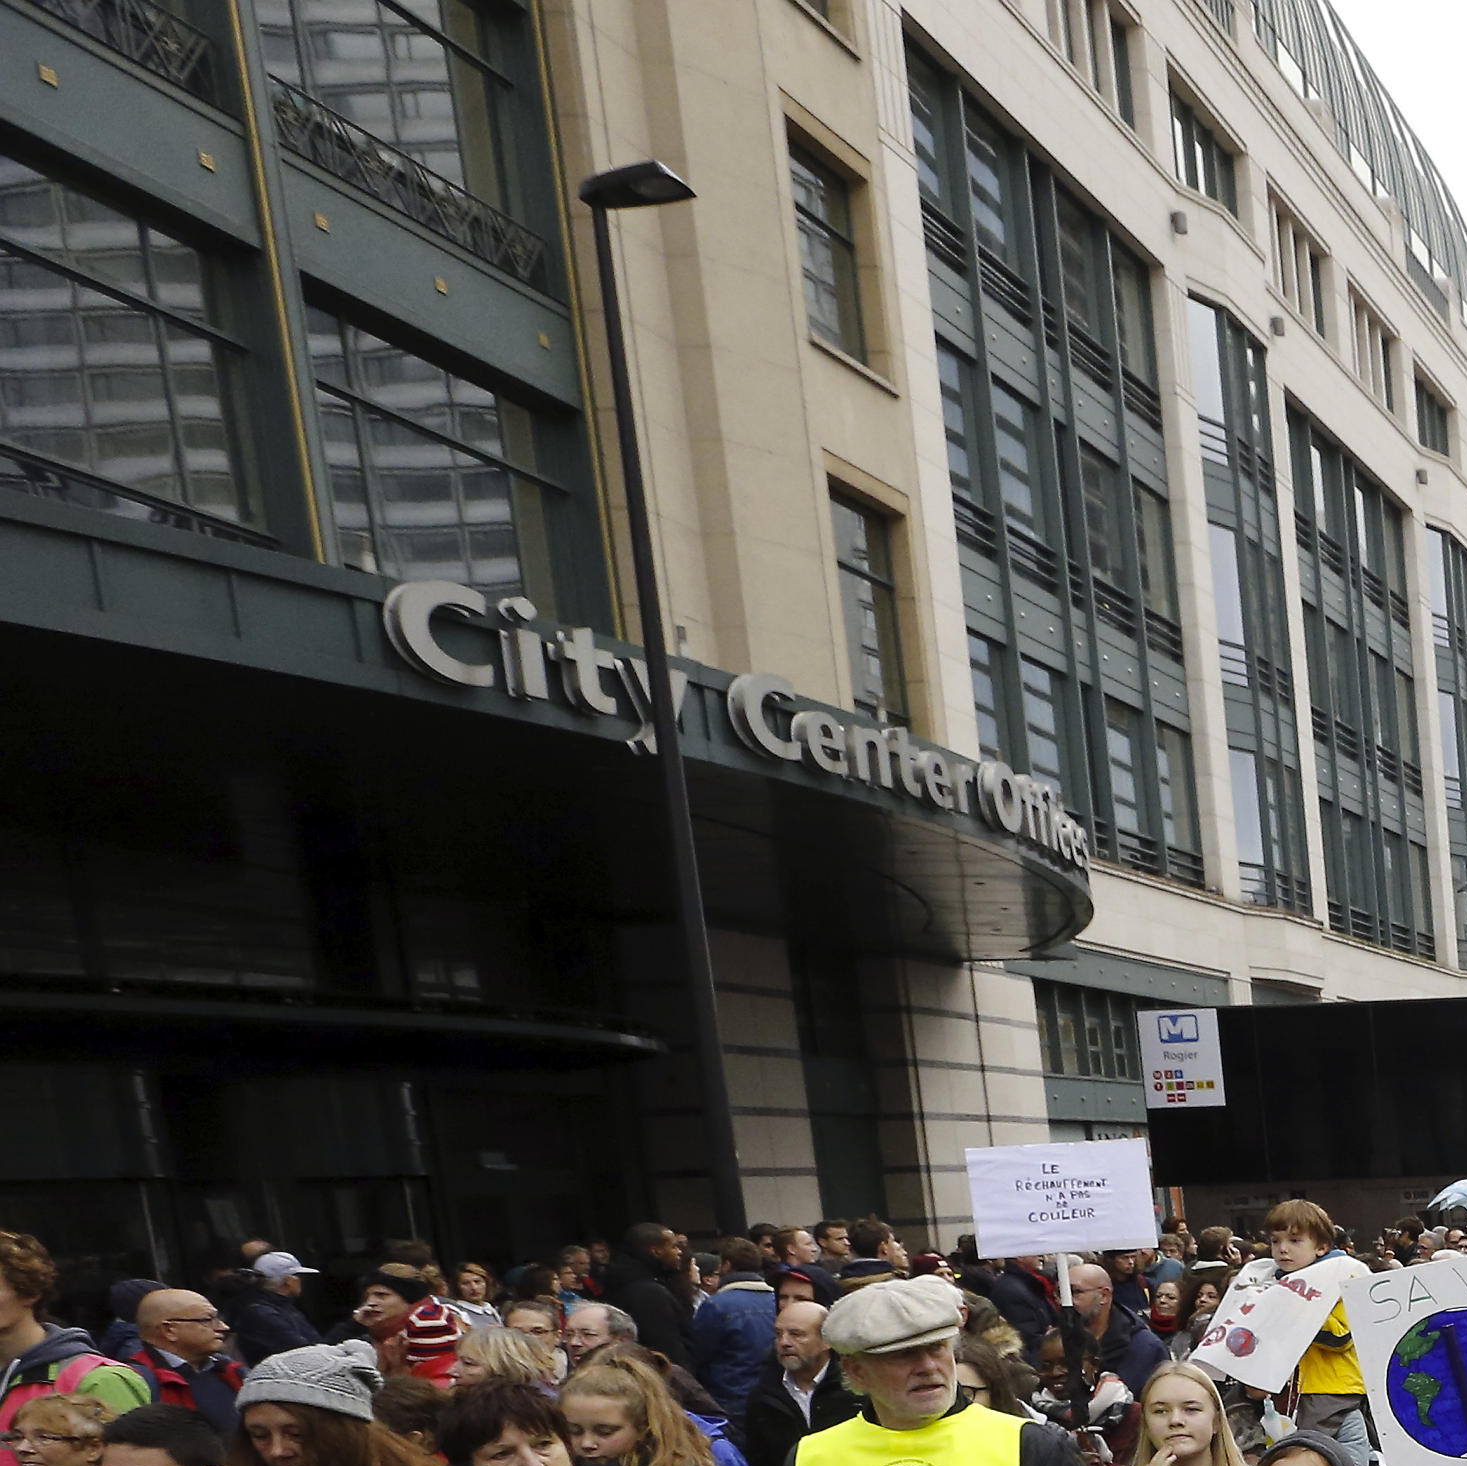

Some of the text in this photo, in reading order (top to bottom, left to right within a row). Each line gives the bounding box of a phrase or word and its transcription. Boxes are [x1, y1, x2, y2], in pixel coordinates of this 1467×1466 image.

[383, 579, 1091, 870] City Center Offices
[1163, 1050, 1198, 1062] Rogier
[1042, 1163, 1060, 1174] LE
[1070, 1191, 1091, 1199] PAS
[1028, 1208, 1095, 1222] COULEUR
